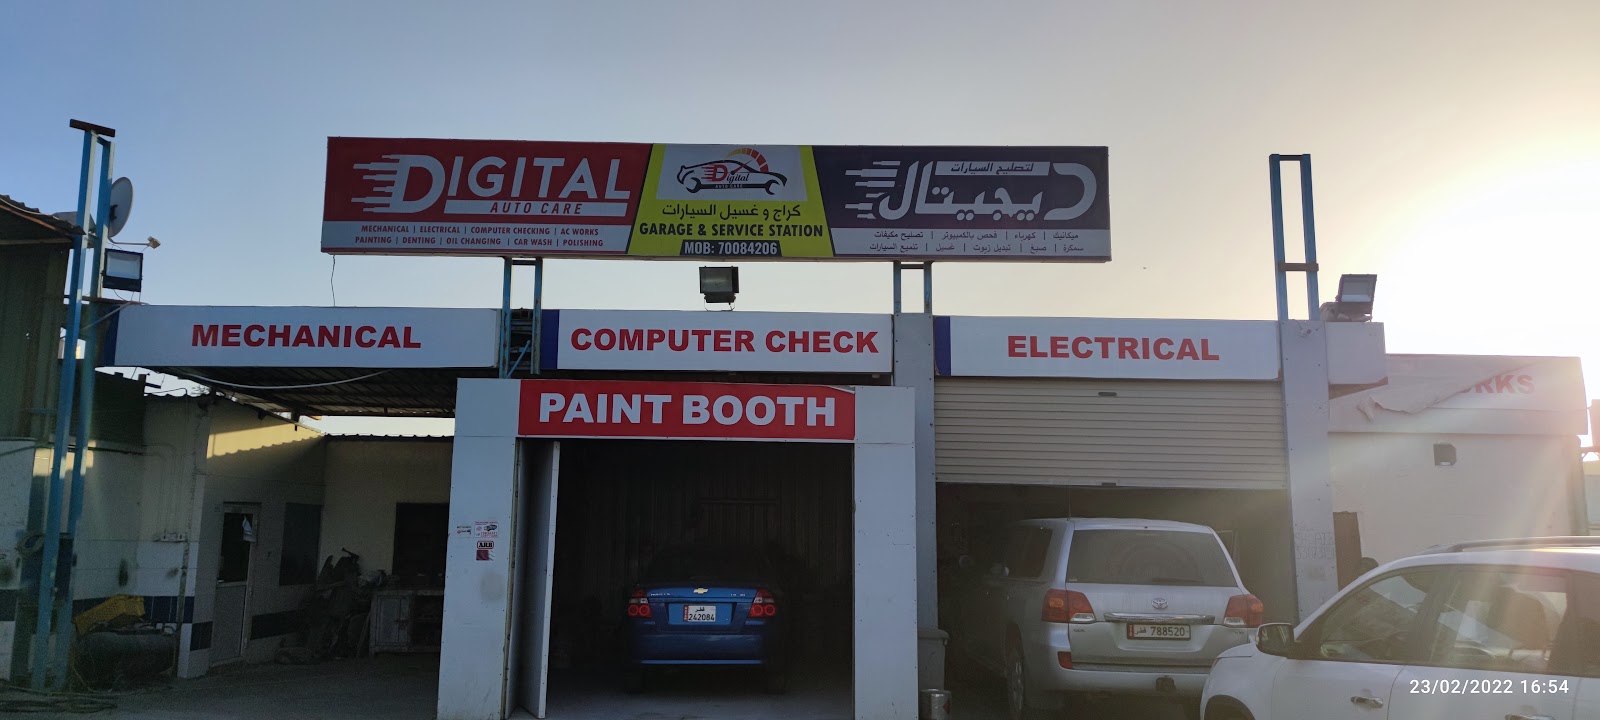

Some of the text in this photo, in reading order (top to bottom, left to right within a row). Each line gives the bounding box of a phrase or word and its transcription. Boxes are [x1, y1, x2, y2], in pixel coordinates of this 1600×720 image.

[702, 164, 750, 184] Digital
[951, 162, 1034, 175] لتصليح السيارات
[352, 154, 630, 213] DIGITAL
[847, 161, 1098, 220] ديجيتال
[490, 202, 583, 215] AUTO CARE
[662, 203, 800, 222] كراج و غسيل السيارات
[361, 225, 599, 236] MECHANICAL ELECTRICAL COMPUTER CHECKING AC WORKS
[639, 222, 823, 237] GARAGE & SERVICE STATION
[874, 230, 899, 240] مكيفات
[977, 230, 998, 241] فحص
[1052, 231, 1079, 240] ميكانيك
[355, 236, 603, 247] PAINTING DENTING OIL CHANGING CAR WASH POLISHING
[900, 231, 924, 241] تصليح
[1014, 231, 1036, 241] كهرباء
[684, 241, 778, 255] MOB: 70084206
[869, 243, 897, 252] السيارات
[993, 244, 1011, 253] تبديل
[1030, 243, 1047, 254] صبغ
[191, 324, 421, 349] MECHANICAL
[570, 328, 879, 353] COMPUTER CHECK
[1007, 336, 1220, 361] ELECTRICAL
[539, 393, 836, 427] PAINT BOOTH
[688, 613, 715, 621] 242084
[1150, 626, 1185, 637] 788520
